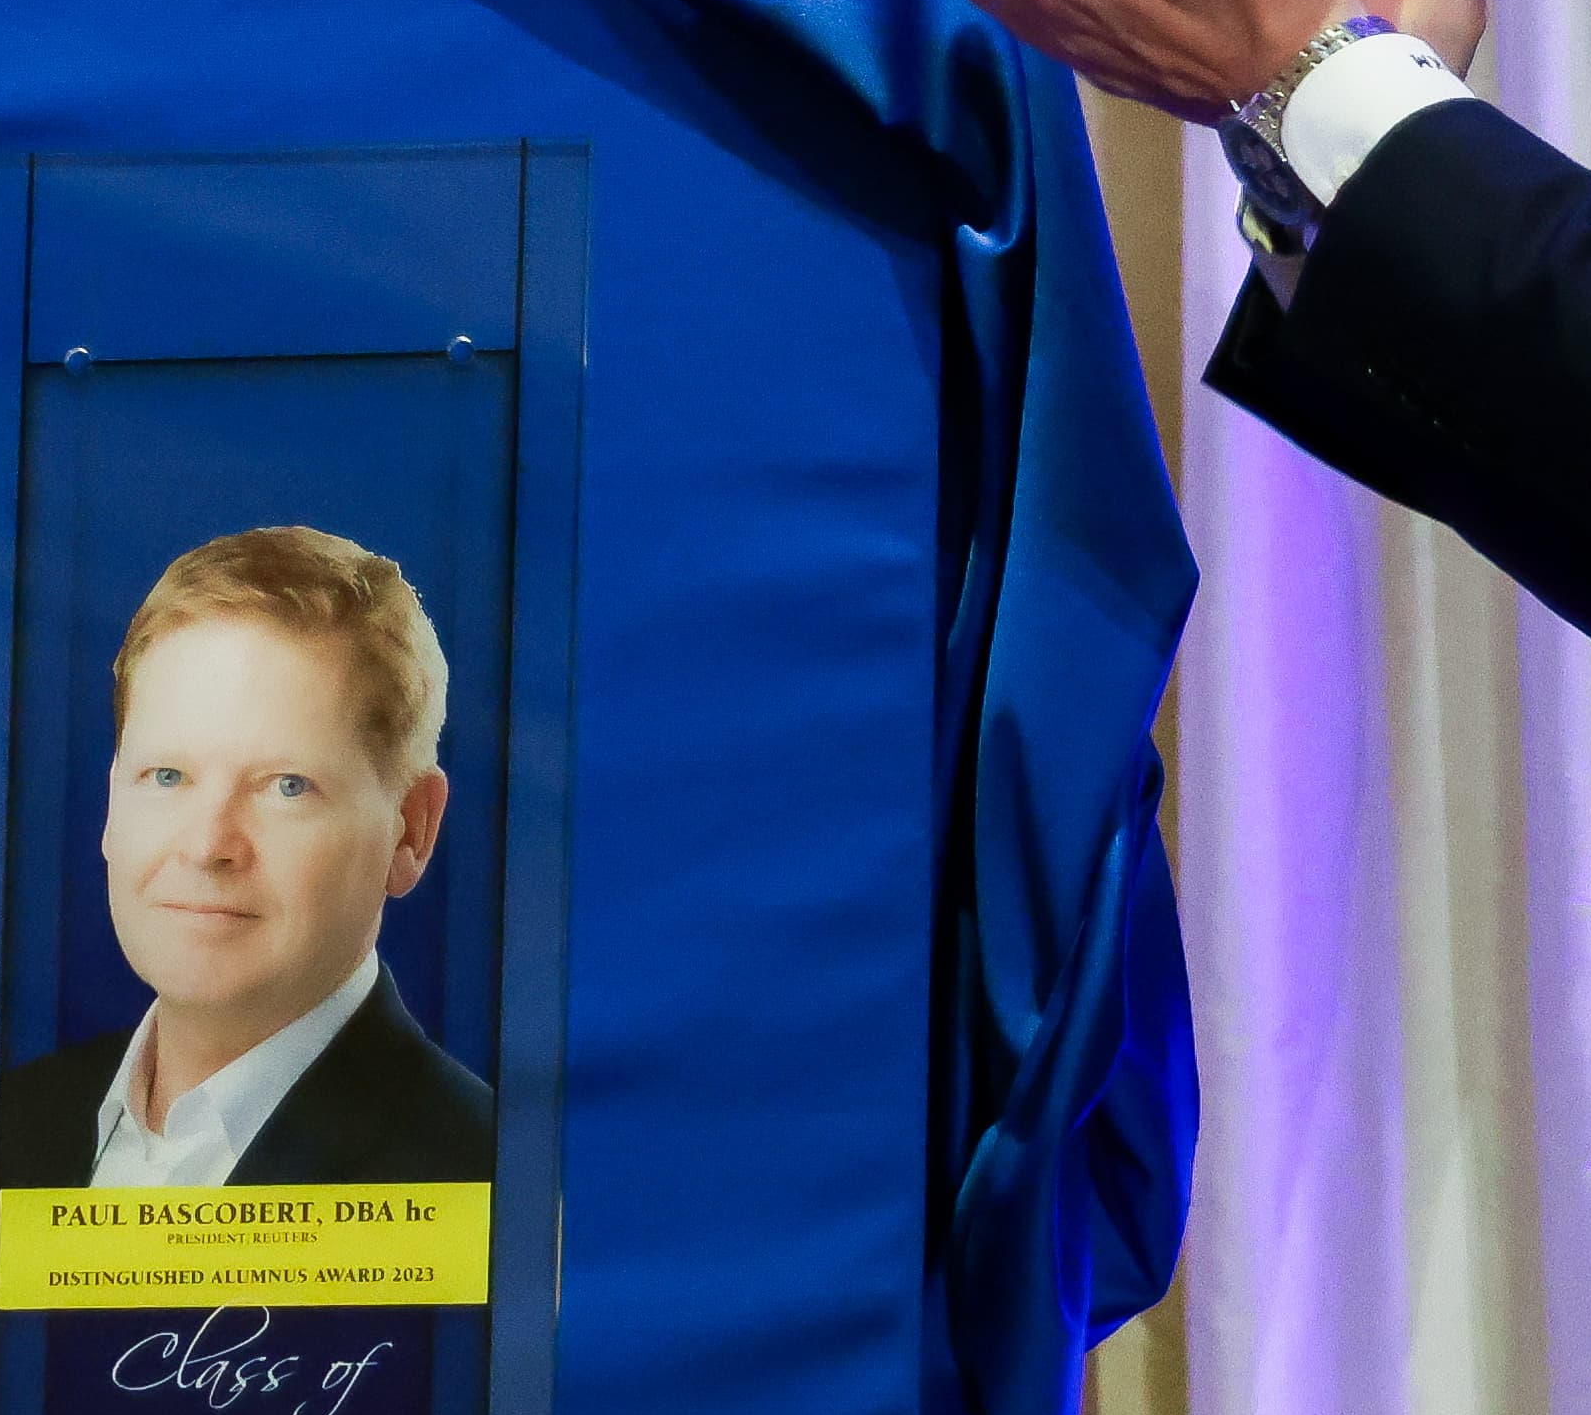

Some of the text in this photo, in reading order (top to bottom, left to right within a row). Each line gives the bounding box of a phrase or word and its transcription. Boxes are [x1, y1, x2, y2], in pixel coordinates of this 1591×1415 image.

[51, 1198, 437, 1227] PAUL BASCOBERT, DBA hc
[252, 1231, 318, 1244] REUTERS
[48, 1266, 435, 1287] DISTINGUISHED ALUMNUS AWARD 2023
[111, 1303, 300, 1409] Class
